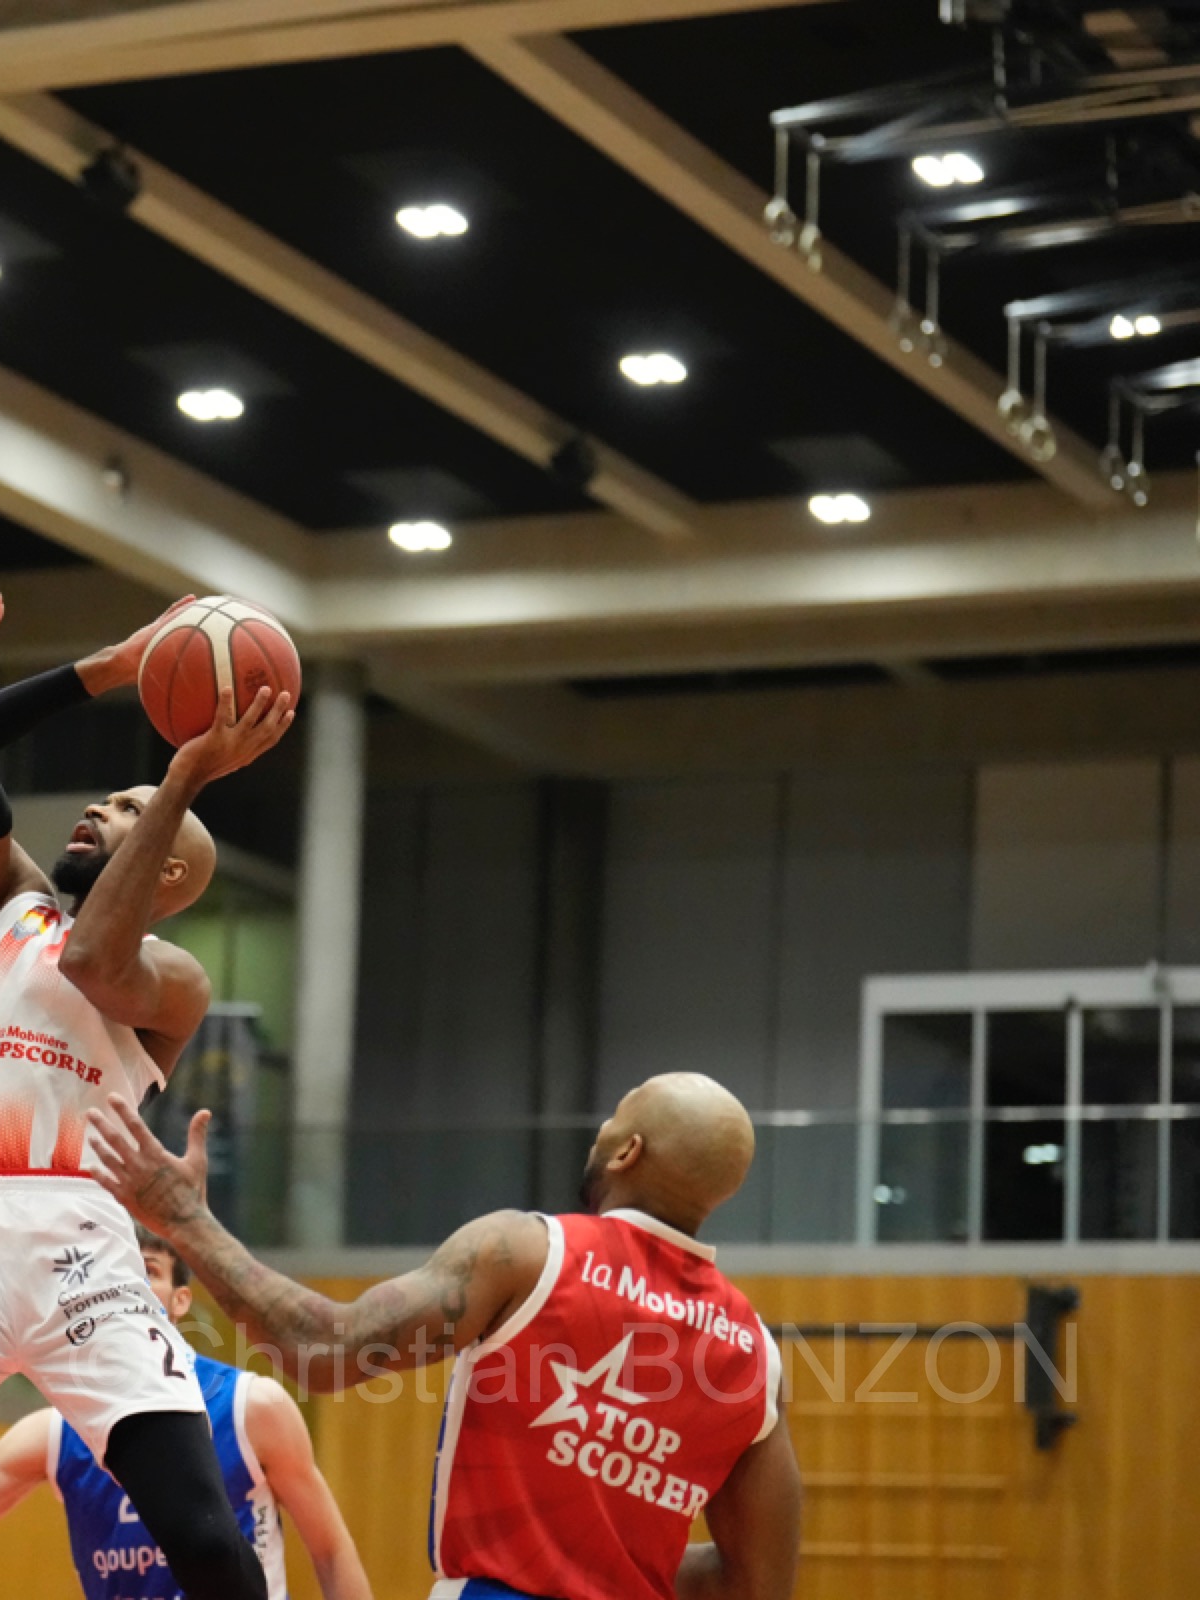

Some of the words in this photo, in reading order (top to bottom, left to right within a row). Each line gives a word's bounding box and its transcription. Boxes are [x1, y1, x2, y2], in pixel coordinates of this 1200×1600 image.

[581, 1251, 611, 1290] la
[617, 1265, 754, 1354] Mobilière
[148, 1327, 187, 1380] 2
[595, 1401, 681, 1464] TOP
[546, 1430, 710, 1520] SCORER
